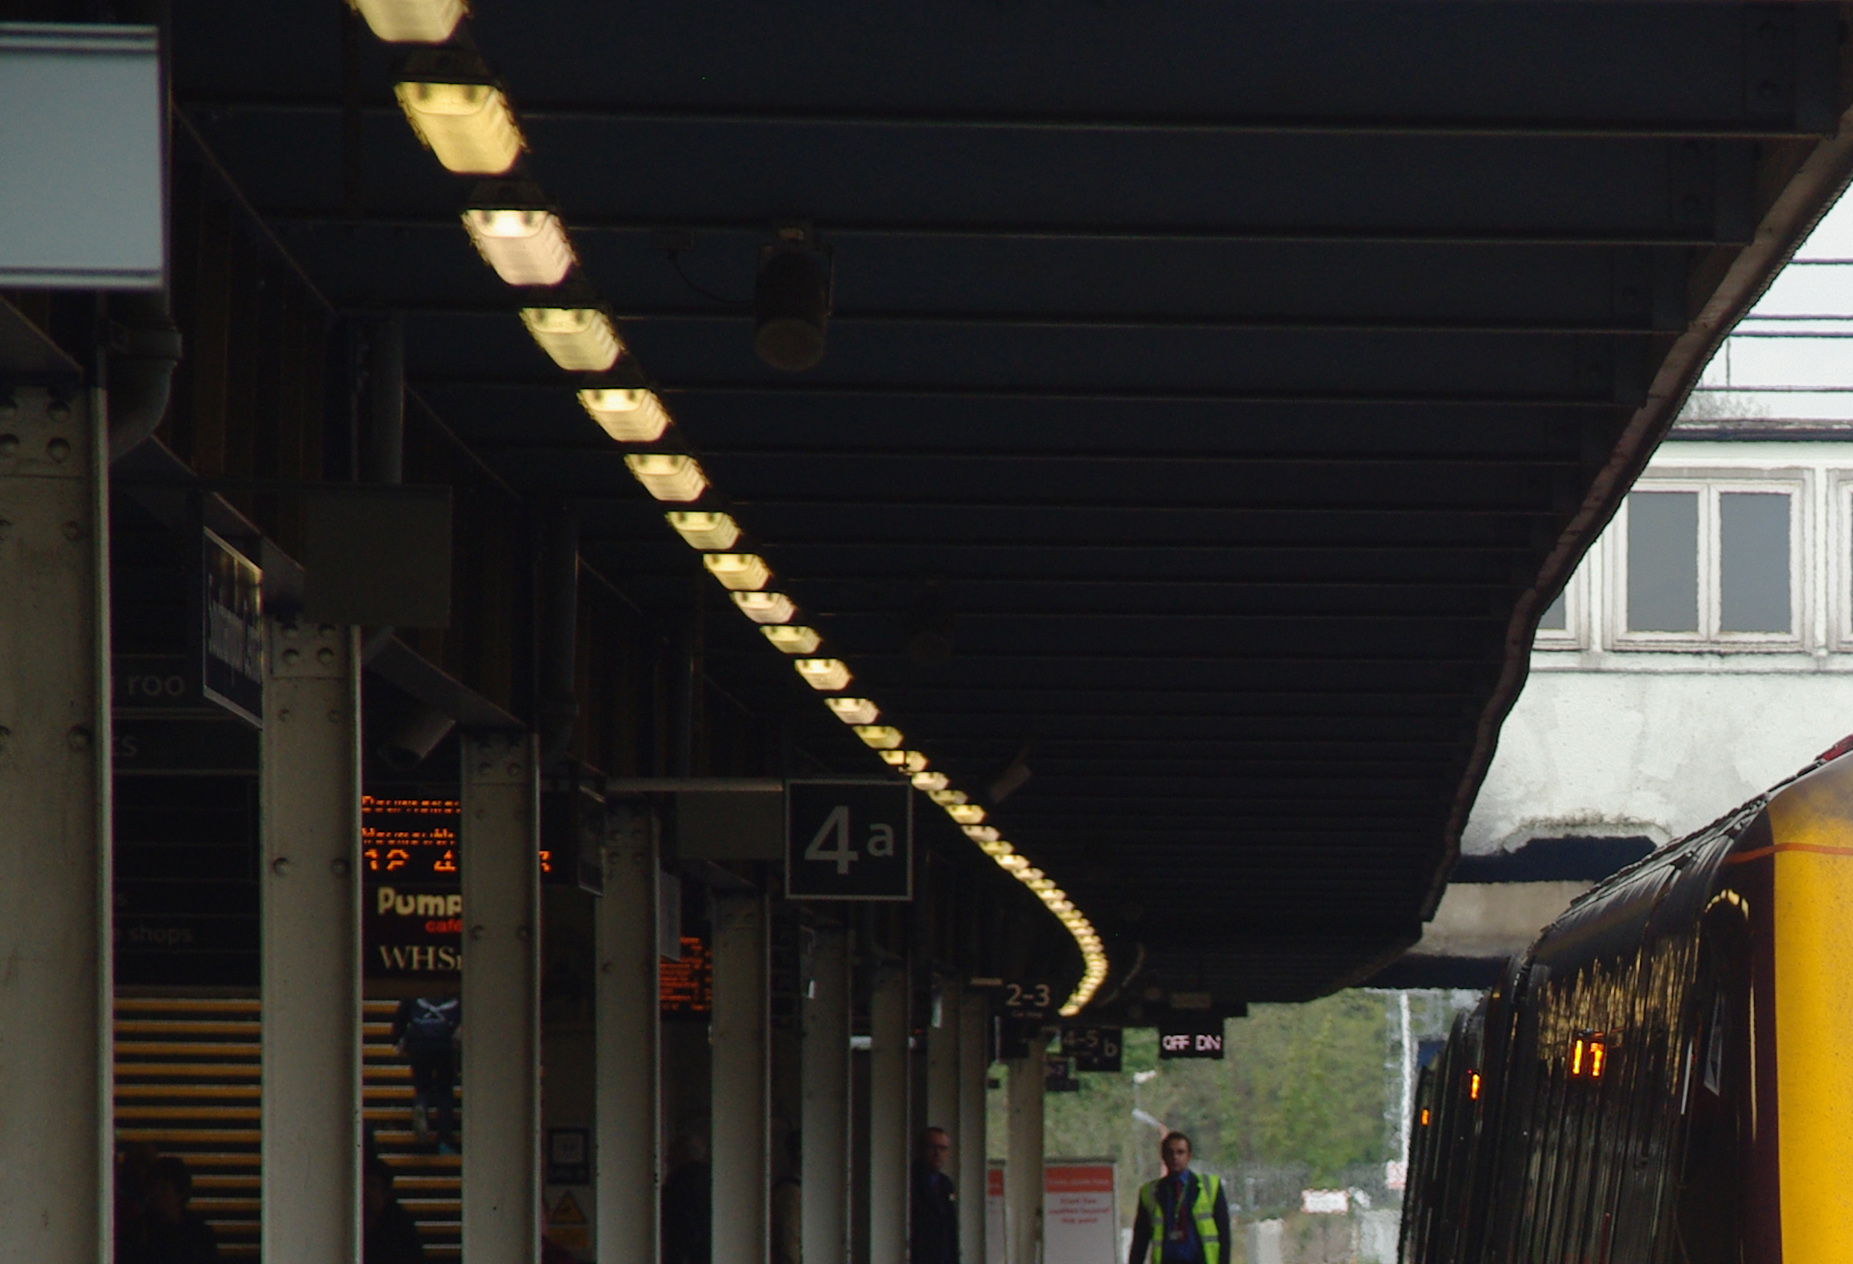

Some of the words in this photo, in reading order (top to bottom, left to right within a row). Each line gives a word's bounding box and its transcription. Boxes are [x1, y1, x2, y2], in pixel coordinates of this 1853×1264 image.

[127, 674, 186, 698] roo
[803, 804, 859, 875] 4
[866, 822, 895, 857] a
[377, 886, 463, 917] Pump
[1005, 982, 1051, 1007] 2-3
[1102, 1038, 1119, 1058] b
[1162, 1034, 1190, 1052] OFF
